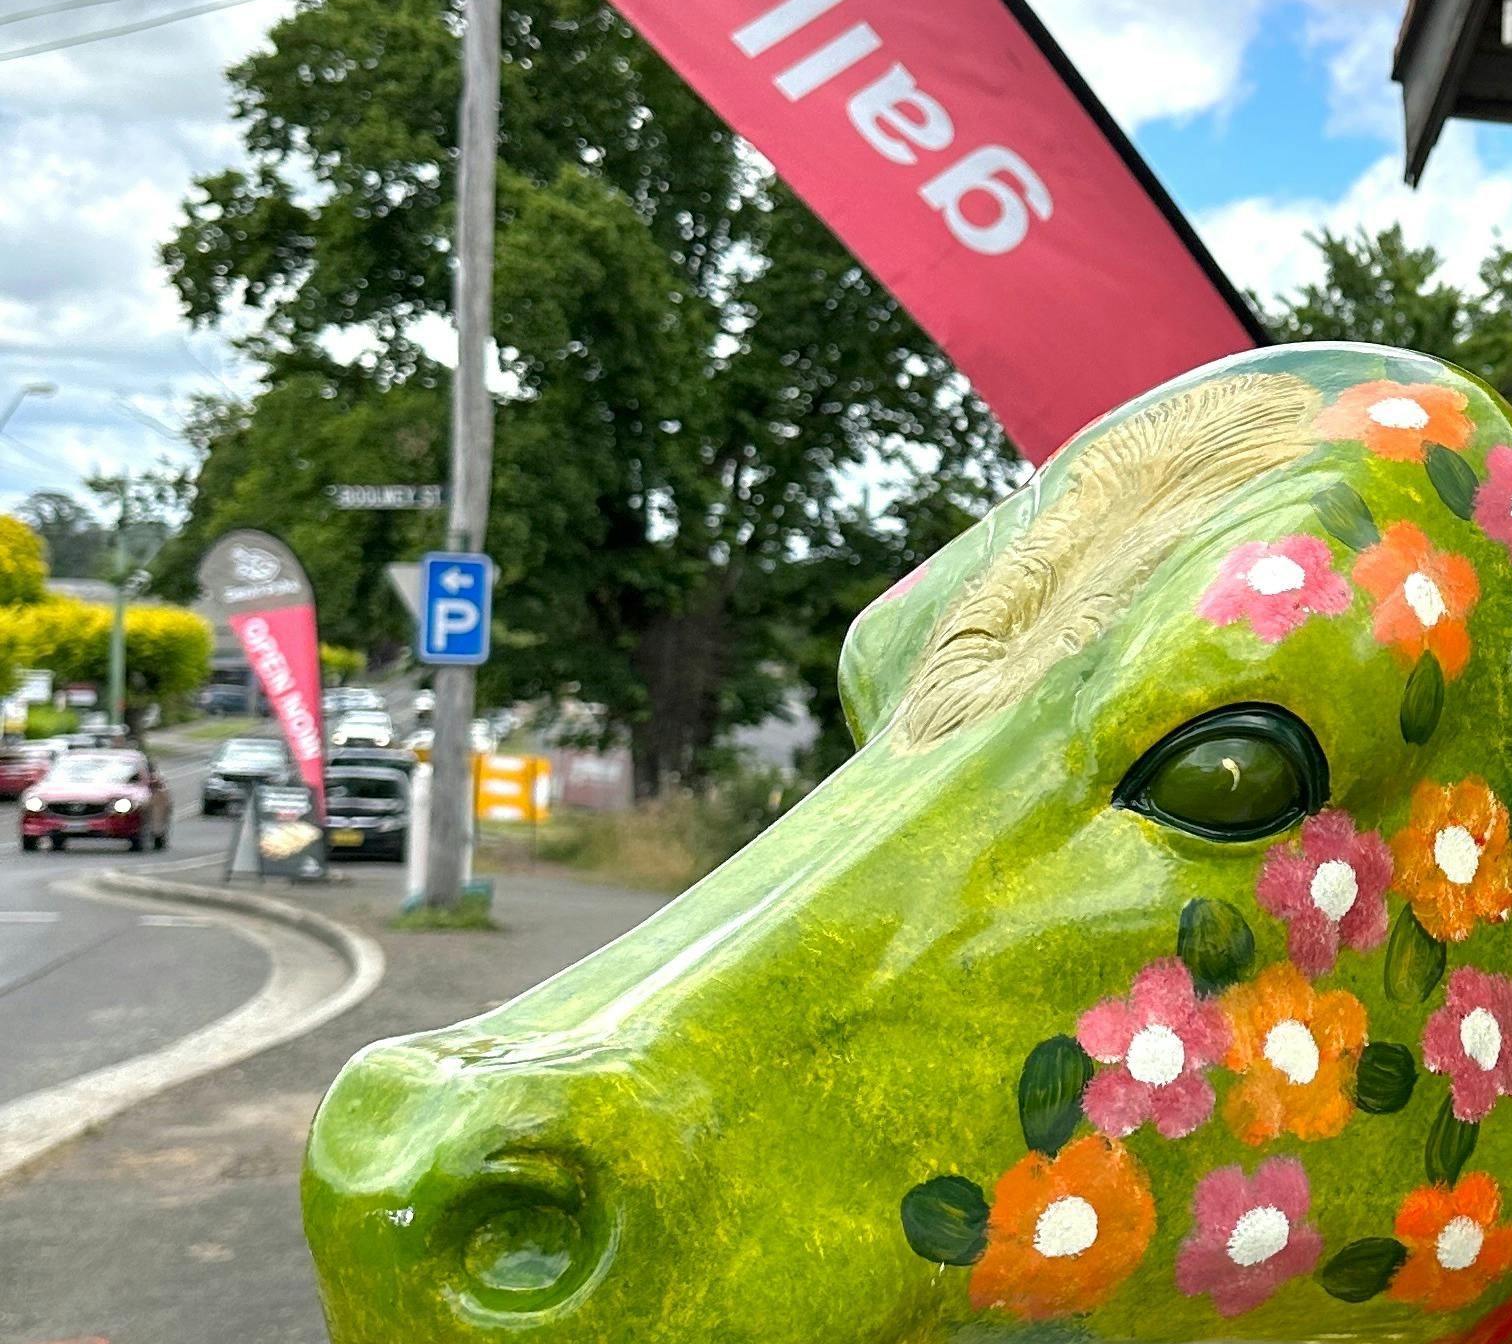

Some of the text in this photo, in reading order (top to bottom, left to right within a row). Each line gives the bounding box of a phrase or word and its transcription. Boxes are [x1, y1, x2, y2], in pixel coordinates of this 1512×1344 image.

[432, 598, 480, 652] P
[244, 617, 297, 696] OPEN
[280, 690, 322, 761] NOW
